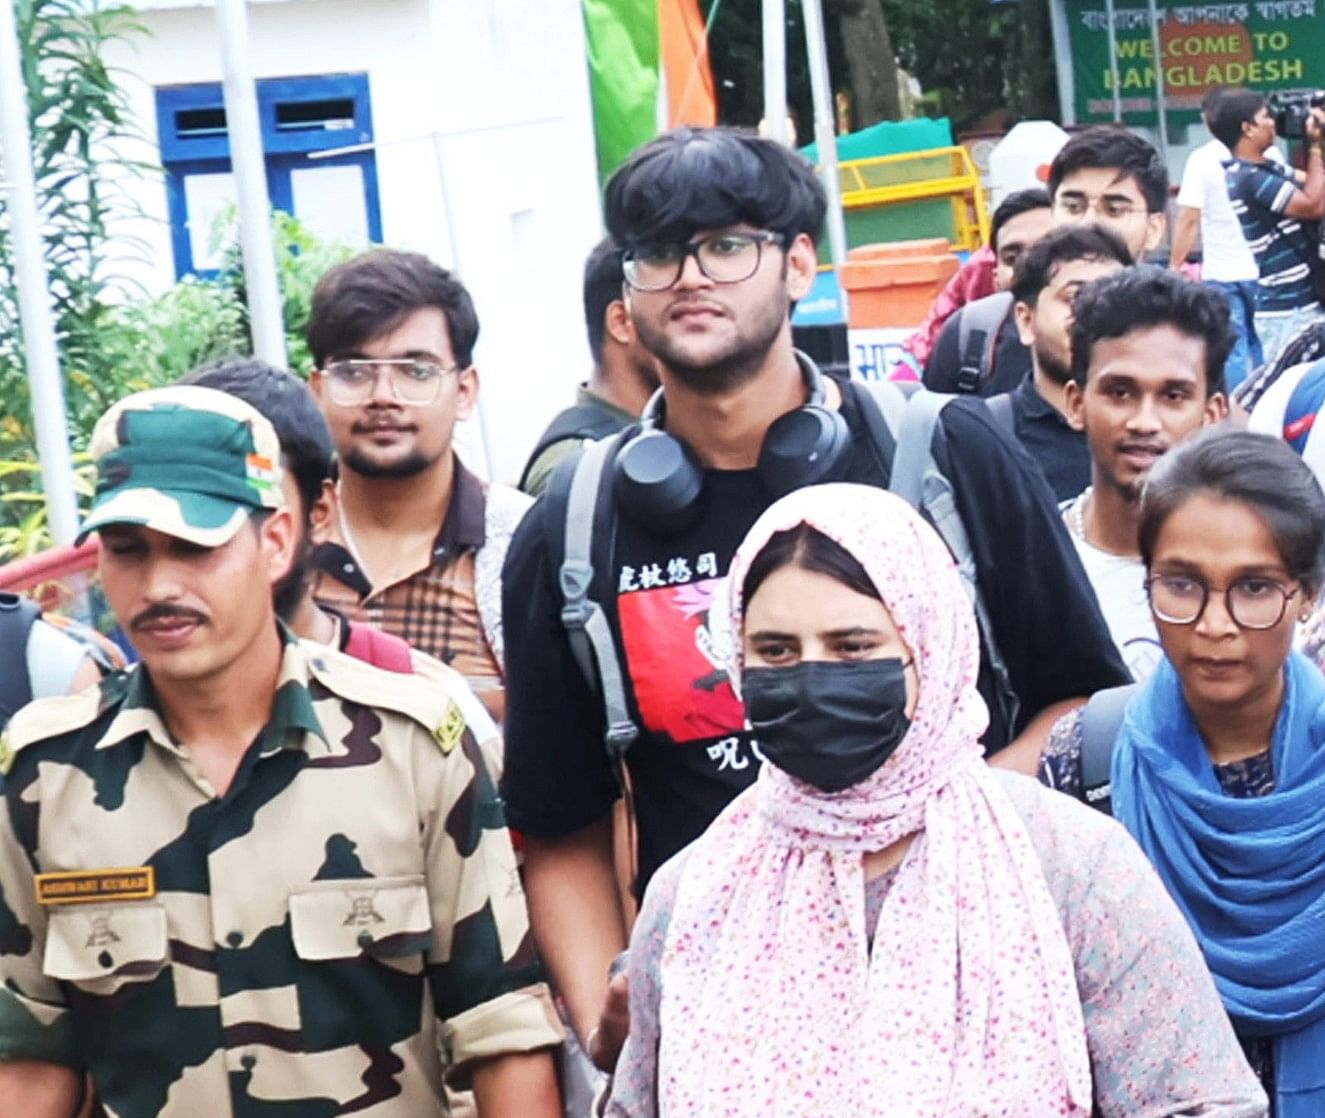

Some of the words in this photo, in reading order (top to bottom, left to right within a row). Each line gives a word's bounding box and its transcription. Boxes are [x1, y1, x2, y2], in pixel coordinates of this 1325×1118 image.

[1114, 34, 1241, 58] WECOME
[1253, 31, 1289, 51] TO
[707, 737, 767, 771] 呪
